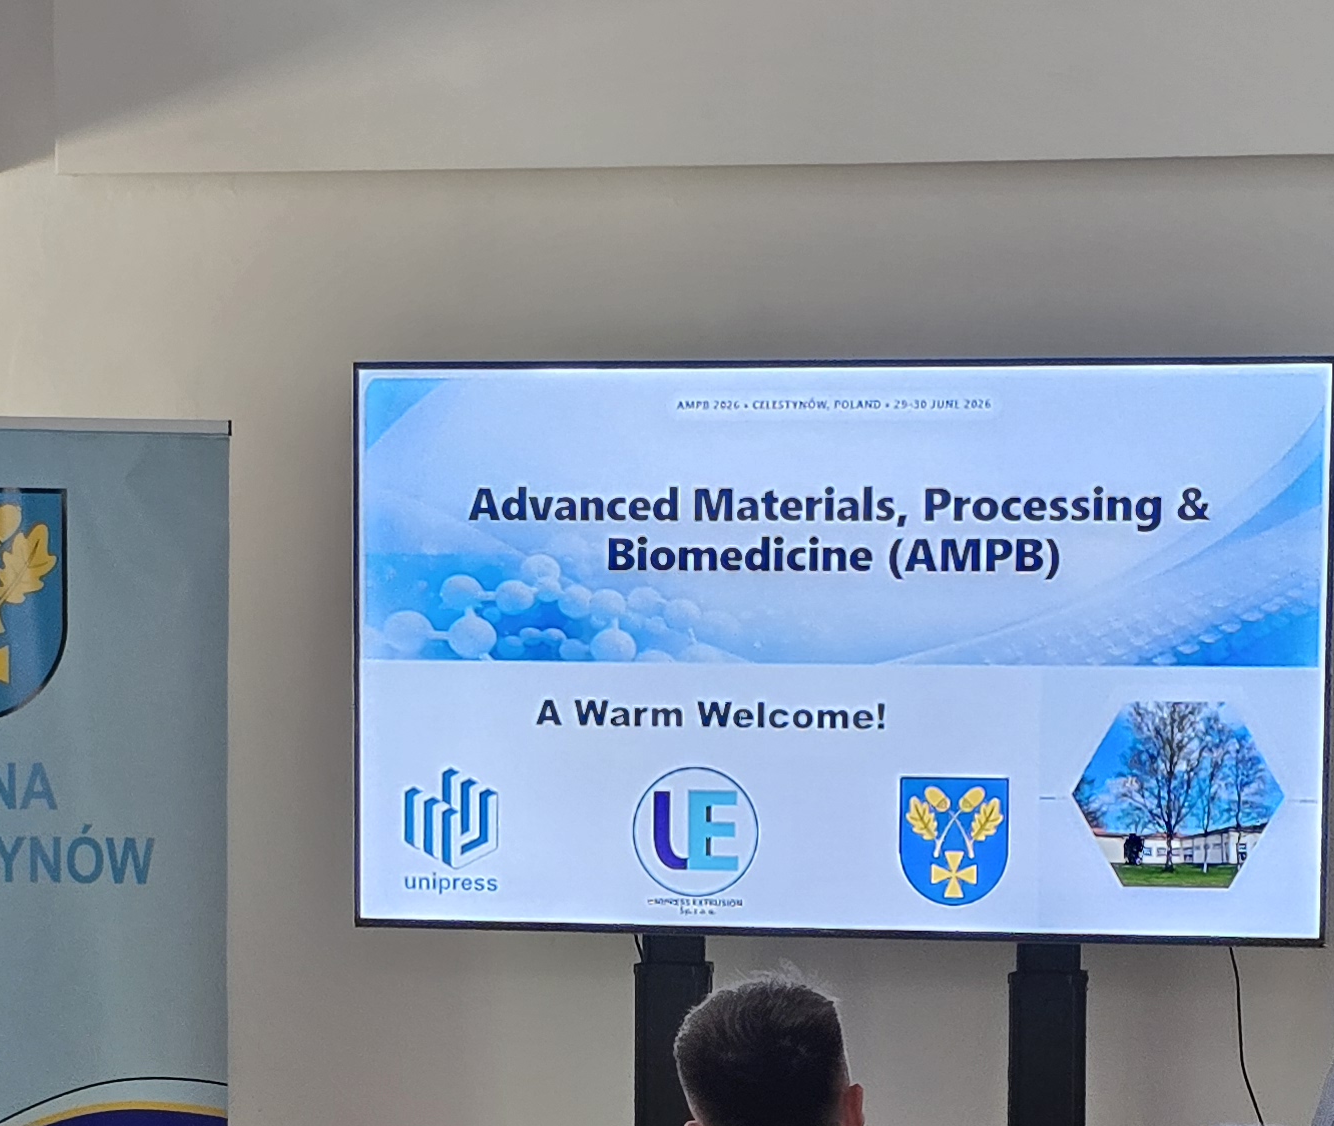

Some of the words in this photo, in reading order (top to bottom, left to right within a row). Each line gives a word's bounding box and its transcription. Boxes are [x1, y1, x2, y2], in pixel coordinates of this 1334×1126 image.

[676, 399, 710, 410] AMPB
[713, 400, 740, 410] 2026
[833, 399, 881, 410] POLAND
[963, 399, 992, 409] 2026
[468, 487, 679, 523] Advanced
[694, 487, 909, 527] Materials,
[924, 487, 1162, 531] Processing
[1177, 489, 1210, 522] &
[607, 537, 873, 573] Biomedicine
[888, 537, 1061, 580] (AMPB)
[536, 701, 562, 726] A
[575, 701, 684, 728] Warm
[697, 701, 887, 730] Welcome!
[404, 872, 499, 894] unipress
